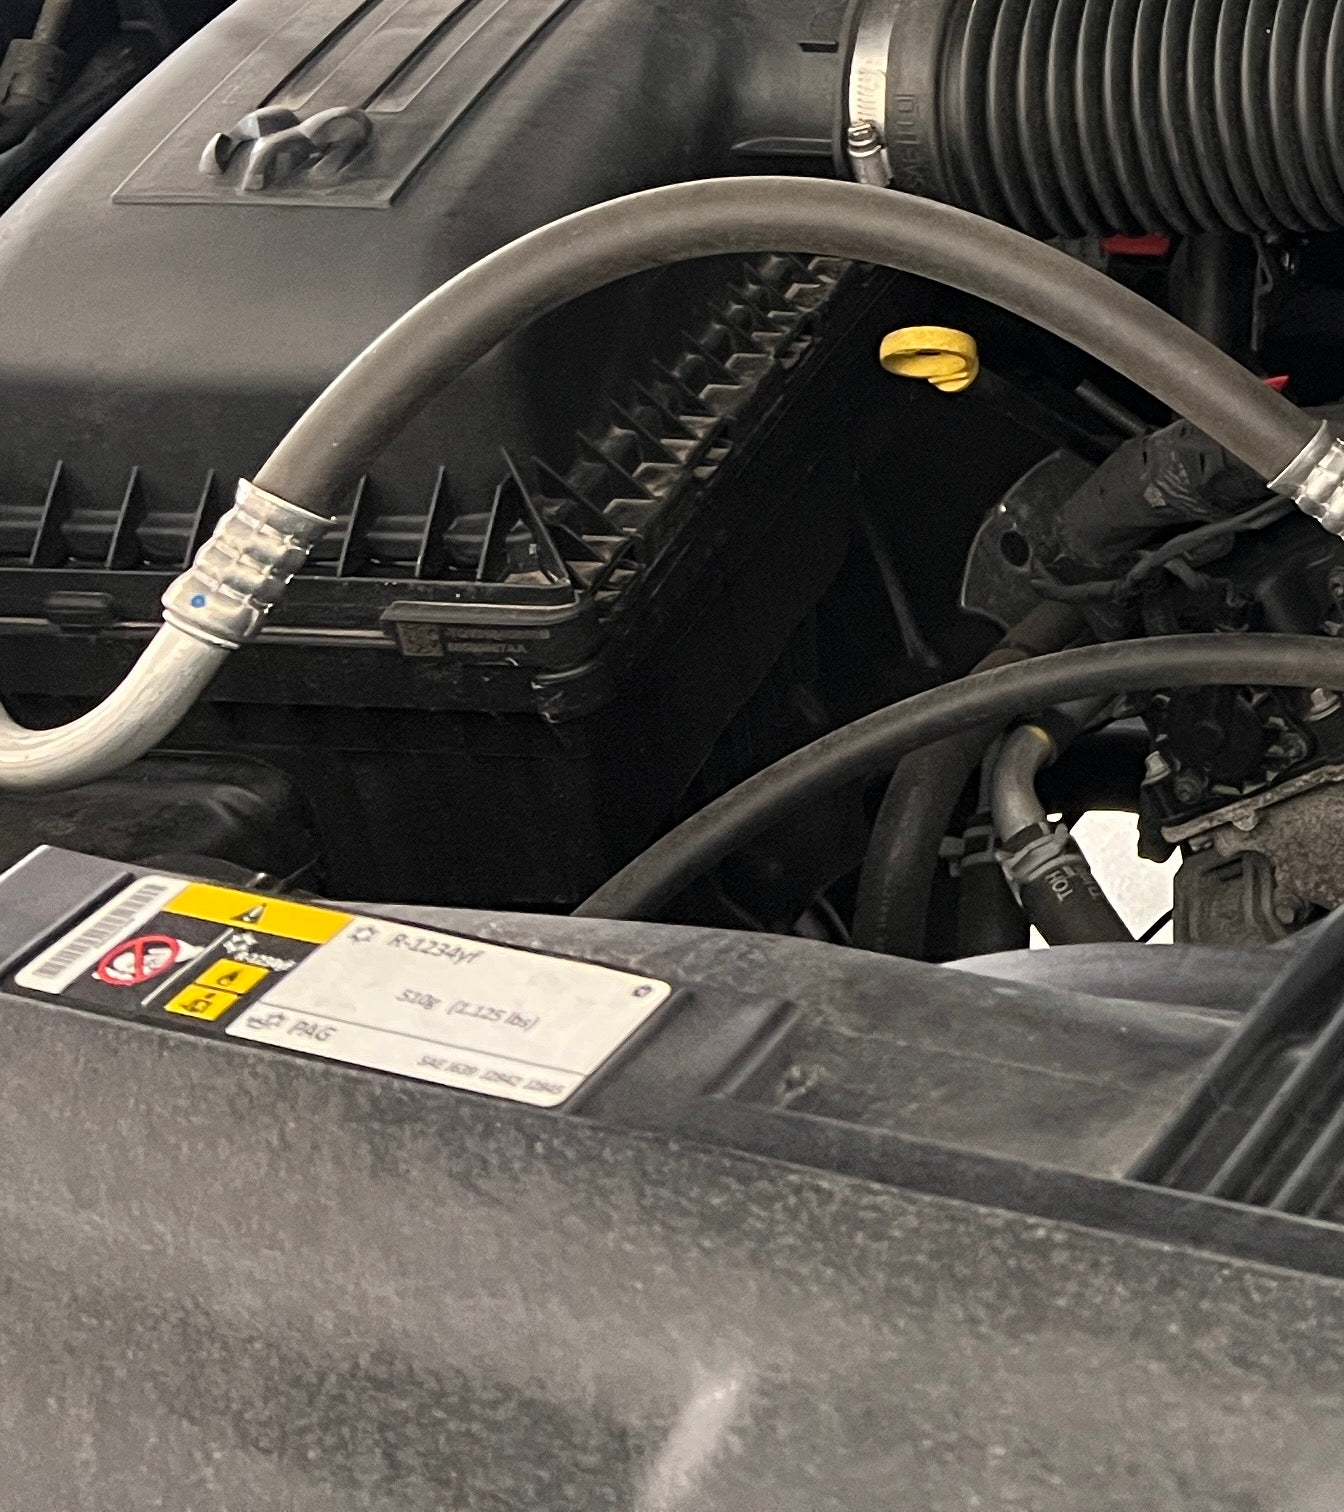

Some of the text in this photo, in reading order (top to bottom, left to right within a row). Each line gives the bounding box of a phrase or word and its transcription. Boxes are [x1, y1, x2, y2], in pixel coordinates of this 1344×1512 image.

[387, 933, 485, 965] R-1234yf
[288, 1020, 337, 1042] PAG
[504, 1010, 541, 1032] lbs)
